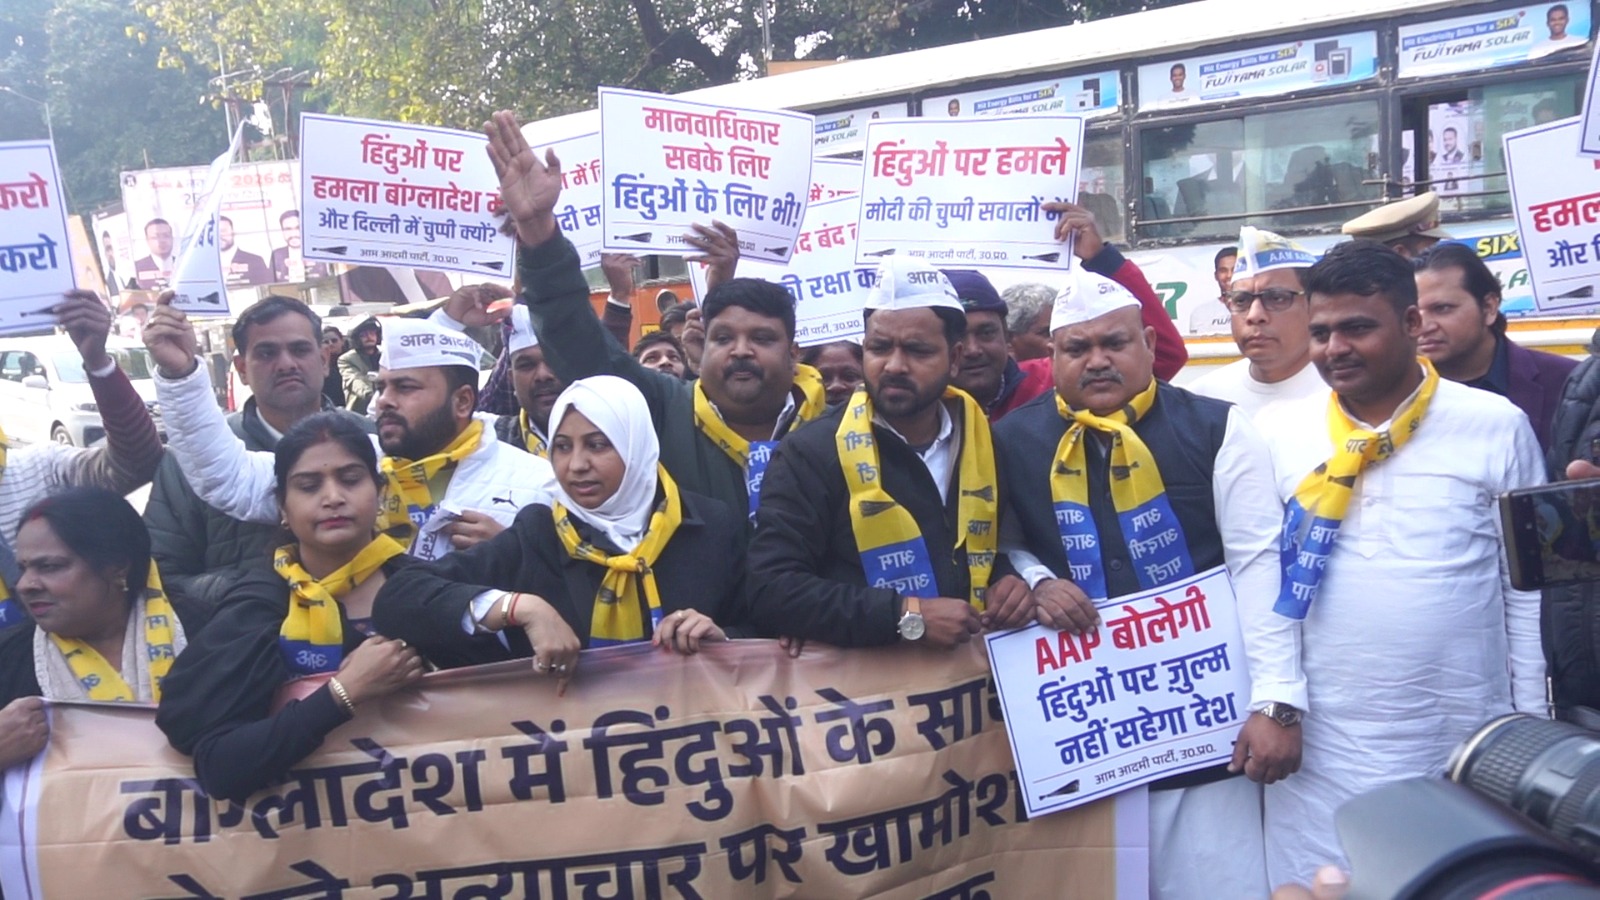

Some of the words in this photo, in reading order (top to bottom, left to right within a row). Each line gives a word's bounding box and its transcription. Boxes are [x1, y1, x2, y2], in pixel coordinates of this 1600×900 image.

[1496, 16, 1517, 29] SIX
[1485, 30, 1531, 48] SOLAR
[1205, 69, 1266, 89] FUJIYAMA
[1268, 60, 1308, 77] SOLAR
[1215, 60, 1241, 71] Energy
[1032, 100, 1064, 113] SOLAR
[642, 107, 780, 146] मानवाधिकार
[361, 133, 428, 174] हिंदुओं
[432, 148, 464, 172] पर
[662, 142, 724, 173] सबके
[728, 145, 771, 180] लिए
[873, 139, 949, 186] हिंदुओं
[954, 148, 991, 176] पर
[996, 137, 1070, 175] हमले
[570, 162, 588, 185] में
[311, 176, 380, 203] हमला
[384, 178, 482, 213] बांग्लादेश
[612, 173, 689, 221] हिंदुओं
[692, 178, 719, 214] के
[722, 182, 768, 221] लिए
[771, 191, 801, 228] भी!
[319, 208, 349, 230] और
[352, 211, 400, 234] दिल्ली
[404, 215, 422, 236] में
[423, 219, 456, 242] चुप्पी
[460, 222, 497, 243] क्यों?
[555, 204, 580, 232] दी
[866, 197, 904, 221] मोदी
[908, 197, 932, 221] की
[936, 196, 974, 229] चुप्पी
[978, 196, 1044, 222] सवालों
[814, 223, 845, 248] बंद
[1476, 234, 1519, 258] SIX
[0, 233, 58, 272] करो
[360, 249, 378, 257] आम
[380, 249, 408, 260] आदमी
[927, 248, 954, 259] आदमी
[1547, 240, 1588, 268] और
[806, 271, 851, 298] रक्षा
[907, 270, 939, 285] आम
[400, 333, 436, 347] आम
[1035, 626, 1101, 675] AAP
[1106, 585, 1211, 650] बोलेगी
[1037, 666, 1115, 723] हिंदुओं
[1118, 663, 1158, 695] पर
[1162, 643, 1230, 694] ज़ुल्म
[1055, 717, 1109, 766] नहीं
[1111, 705, 1187, 749] सहेगा
[1190, 692, 1238, 728] देश
[120, 737, 486, 845] बाग्लादेश
[502, 719, 568, 804] में
[584, 695, 803, 822] हिंदुओं
[815, 688, 896, 764] के
[1094, 769, 1117, 785] आम
[1118, 756, 1150, 777] आदमी
[1152, 749, 1178, 766] पार्टी,
[720, 823, 806, 885] पर
